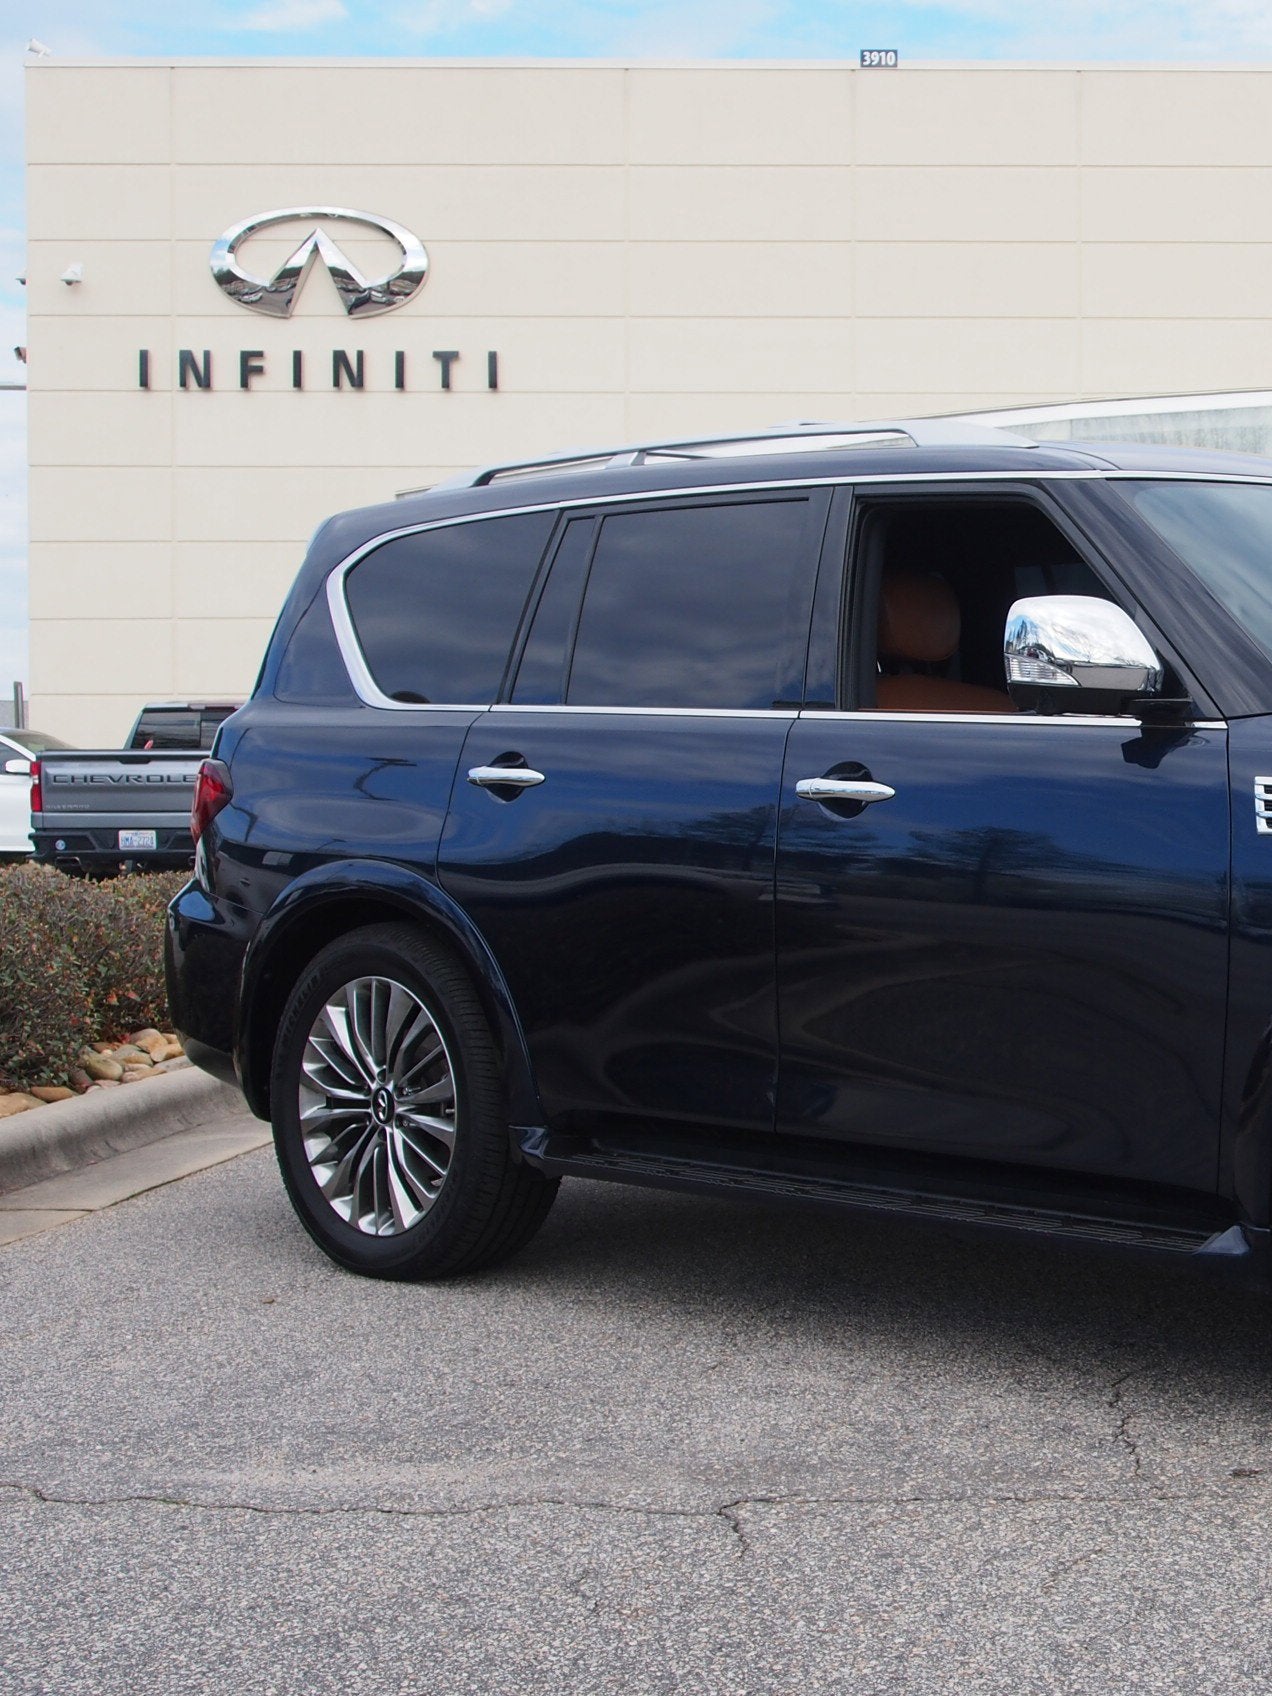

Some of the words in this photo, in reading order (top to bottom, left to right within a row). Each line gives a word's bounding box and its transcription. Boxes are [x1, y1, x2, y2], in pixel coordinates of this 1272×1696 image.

[862, 51, 896, 66] 3910
[138, 349, 498, 389] INFINITI
[53, 774, 197, 784] CHEVROLE
